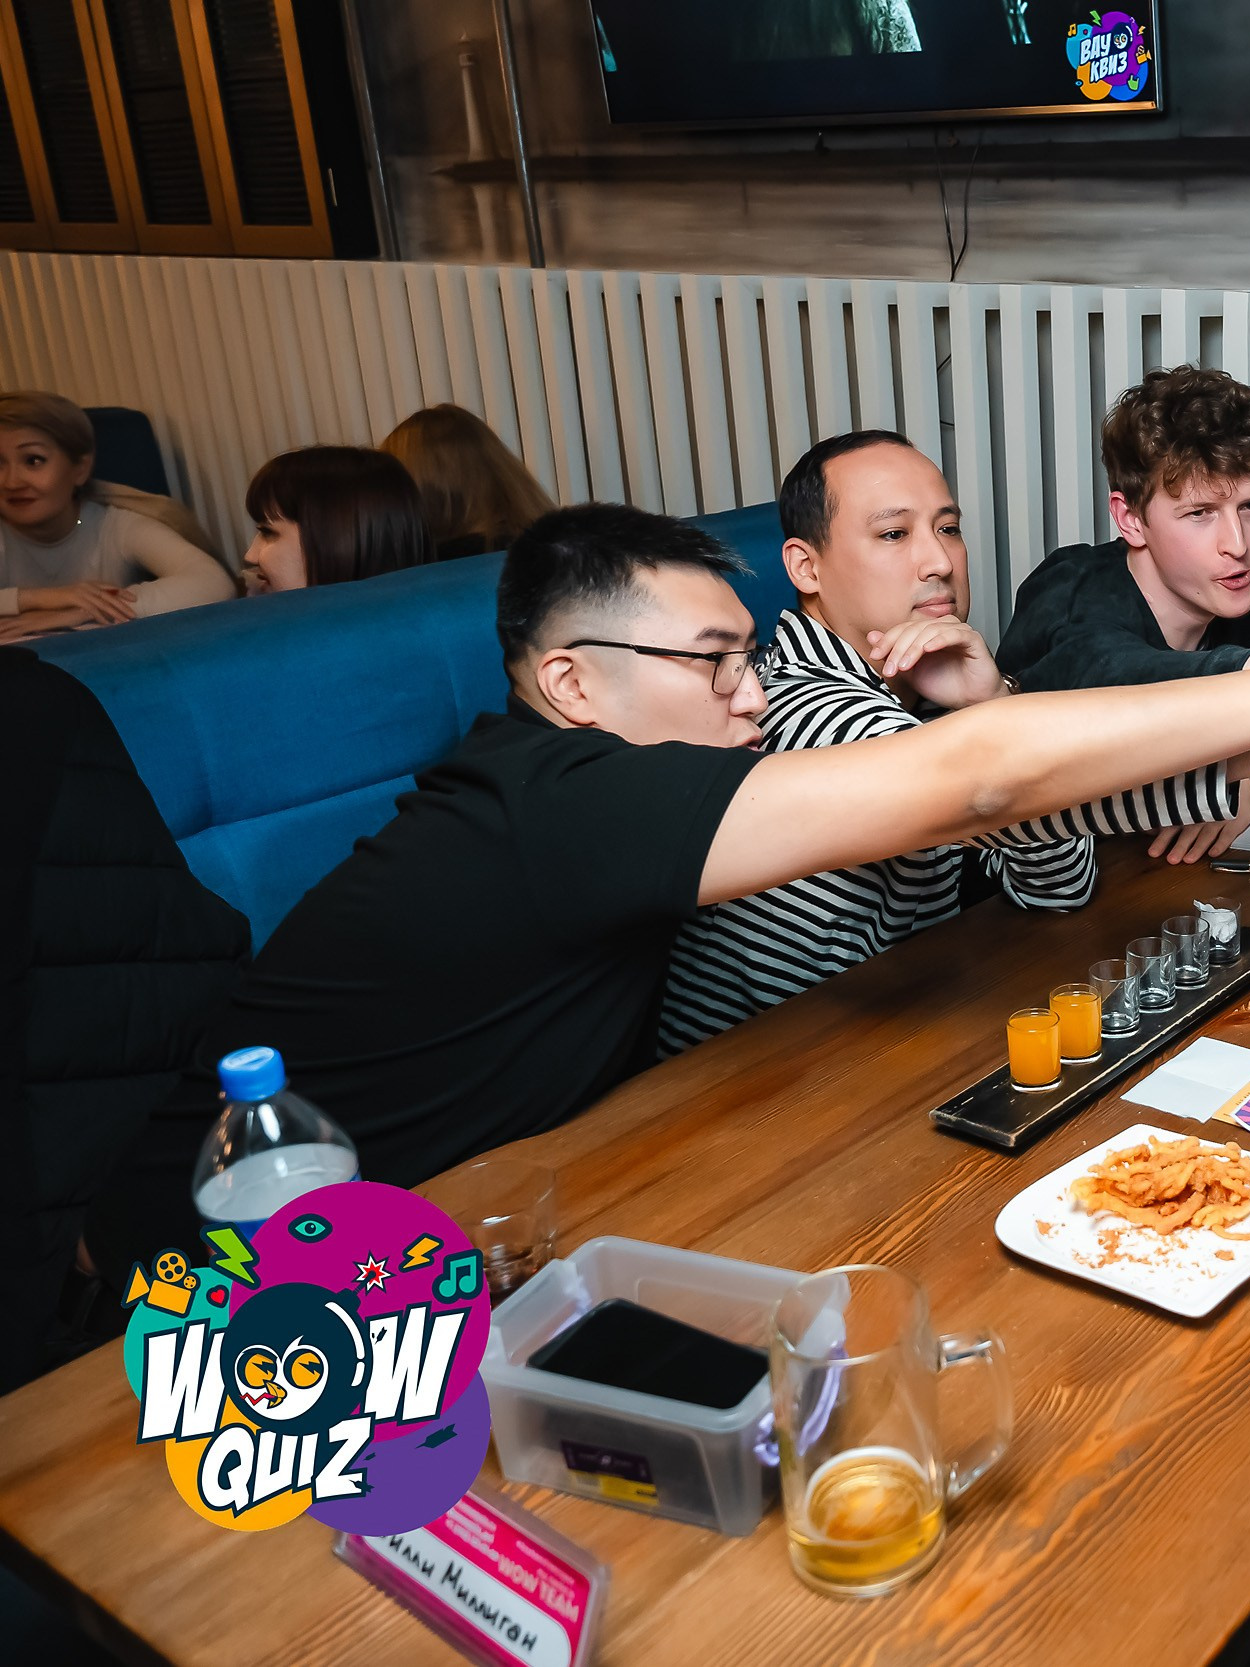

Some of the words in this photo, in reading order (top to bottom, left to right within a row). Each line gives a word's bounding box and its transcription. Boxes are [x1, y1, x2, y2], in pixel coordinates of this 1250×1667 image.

[1080, 33, 1111, 65] ВАУ
[1090, 51, 1128, 82] КВИЗ
[379, 1535, 435, 1578] илли
[497, 1554, 539, 1594] WOW
[536, 1580, 580, 1624] TEAM
